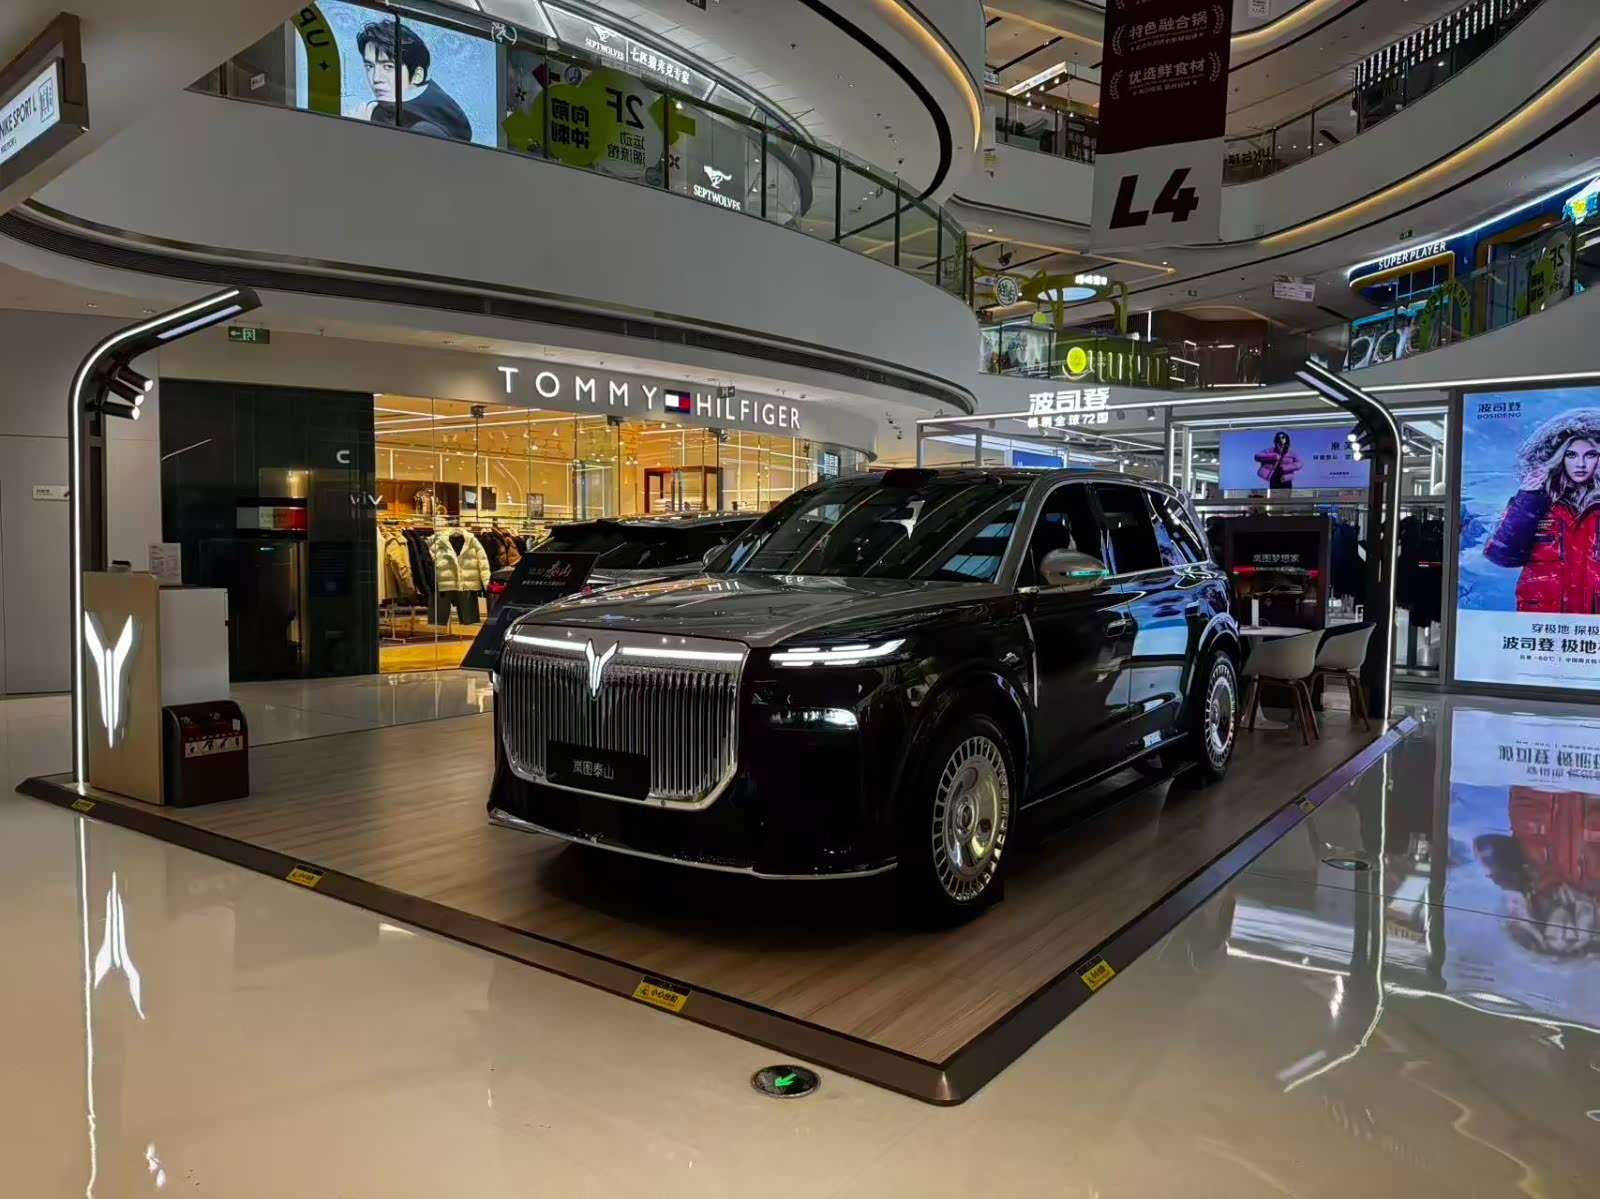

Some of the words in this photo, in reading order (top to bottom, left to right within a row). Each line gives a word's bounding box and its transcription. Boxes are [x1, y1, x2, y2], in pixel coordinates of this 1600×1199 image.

[1129, 10, 1208, 40] 特色融合锅
[585, 37, 625, 61] SEPTWOLVES
[630, 47, 690, 84] 七匹狼夹克专家
[1128, 58, 1206, 85] 优选鲜食材
[13, 96, 32, 128] SPORT
[693, 184, 741, 211] SEPTWOLVES
[1109, 167, 1200, 230] L4
[1378, 250, 1409, 271] SUPER
[1409, 242, 1447, 262] PLAYER
[497, 366, 658, 410] TOMMY
[696, 393, 802, 430] HILFIGER
[1028, 387, 1111, 415] 波司登
[1477, 401, 1522, 413] 波司登
[1477, 412, 1522, 420] BOSIDENG
[1531, 623, 1570, 634] 穿极地
[1502, 636, 1555, 652] 波司登
[1561, 638, 1600, 654] 极地
[573, 760, 615, 780] 岚图泰山
